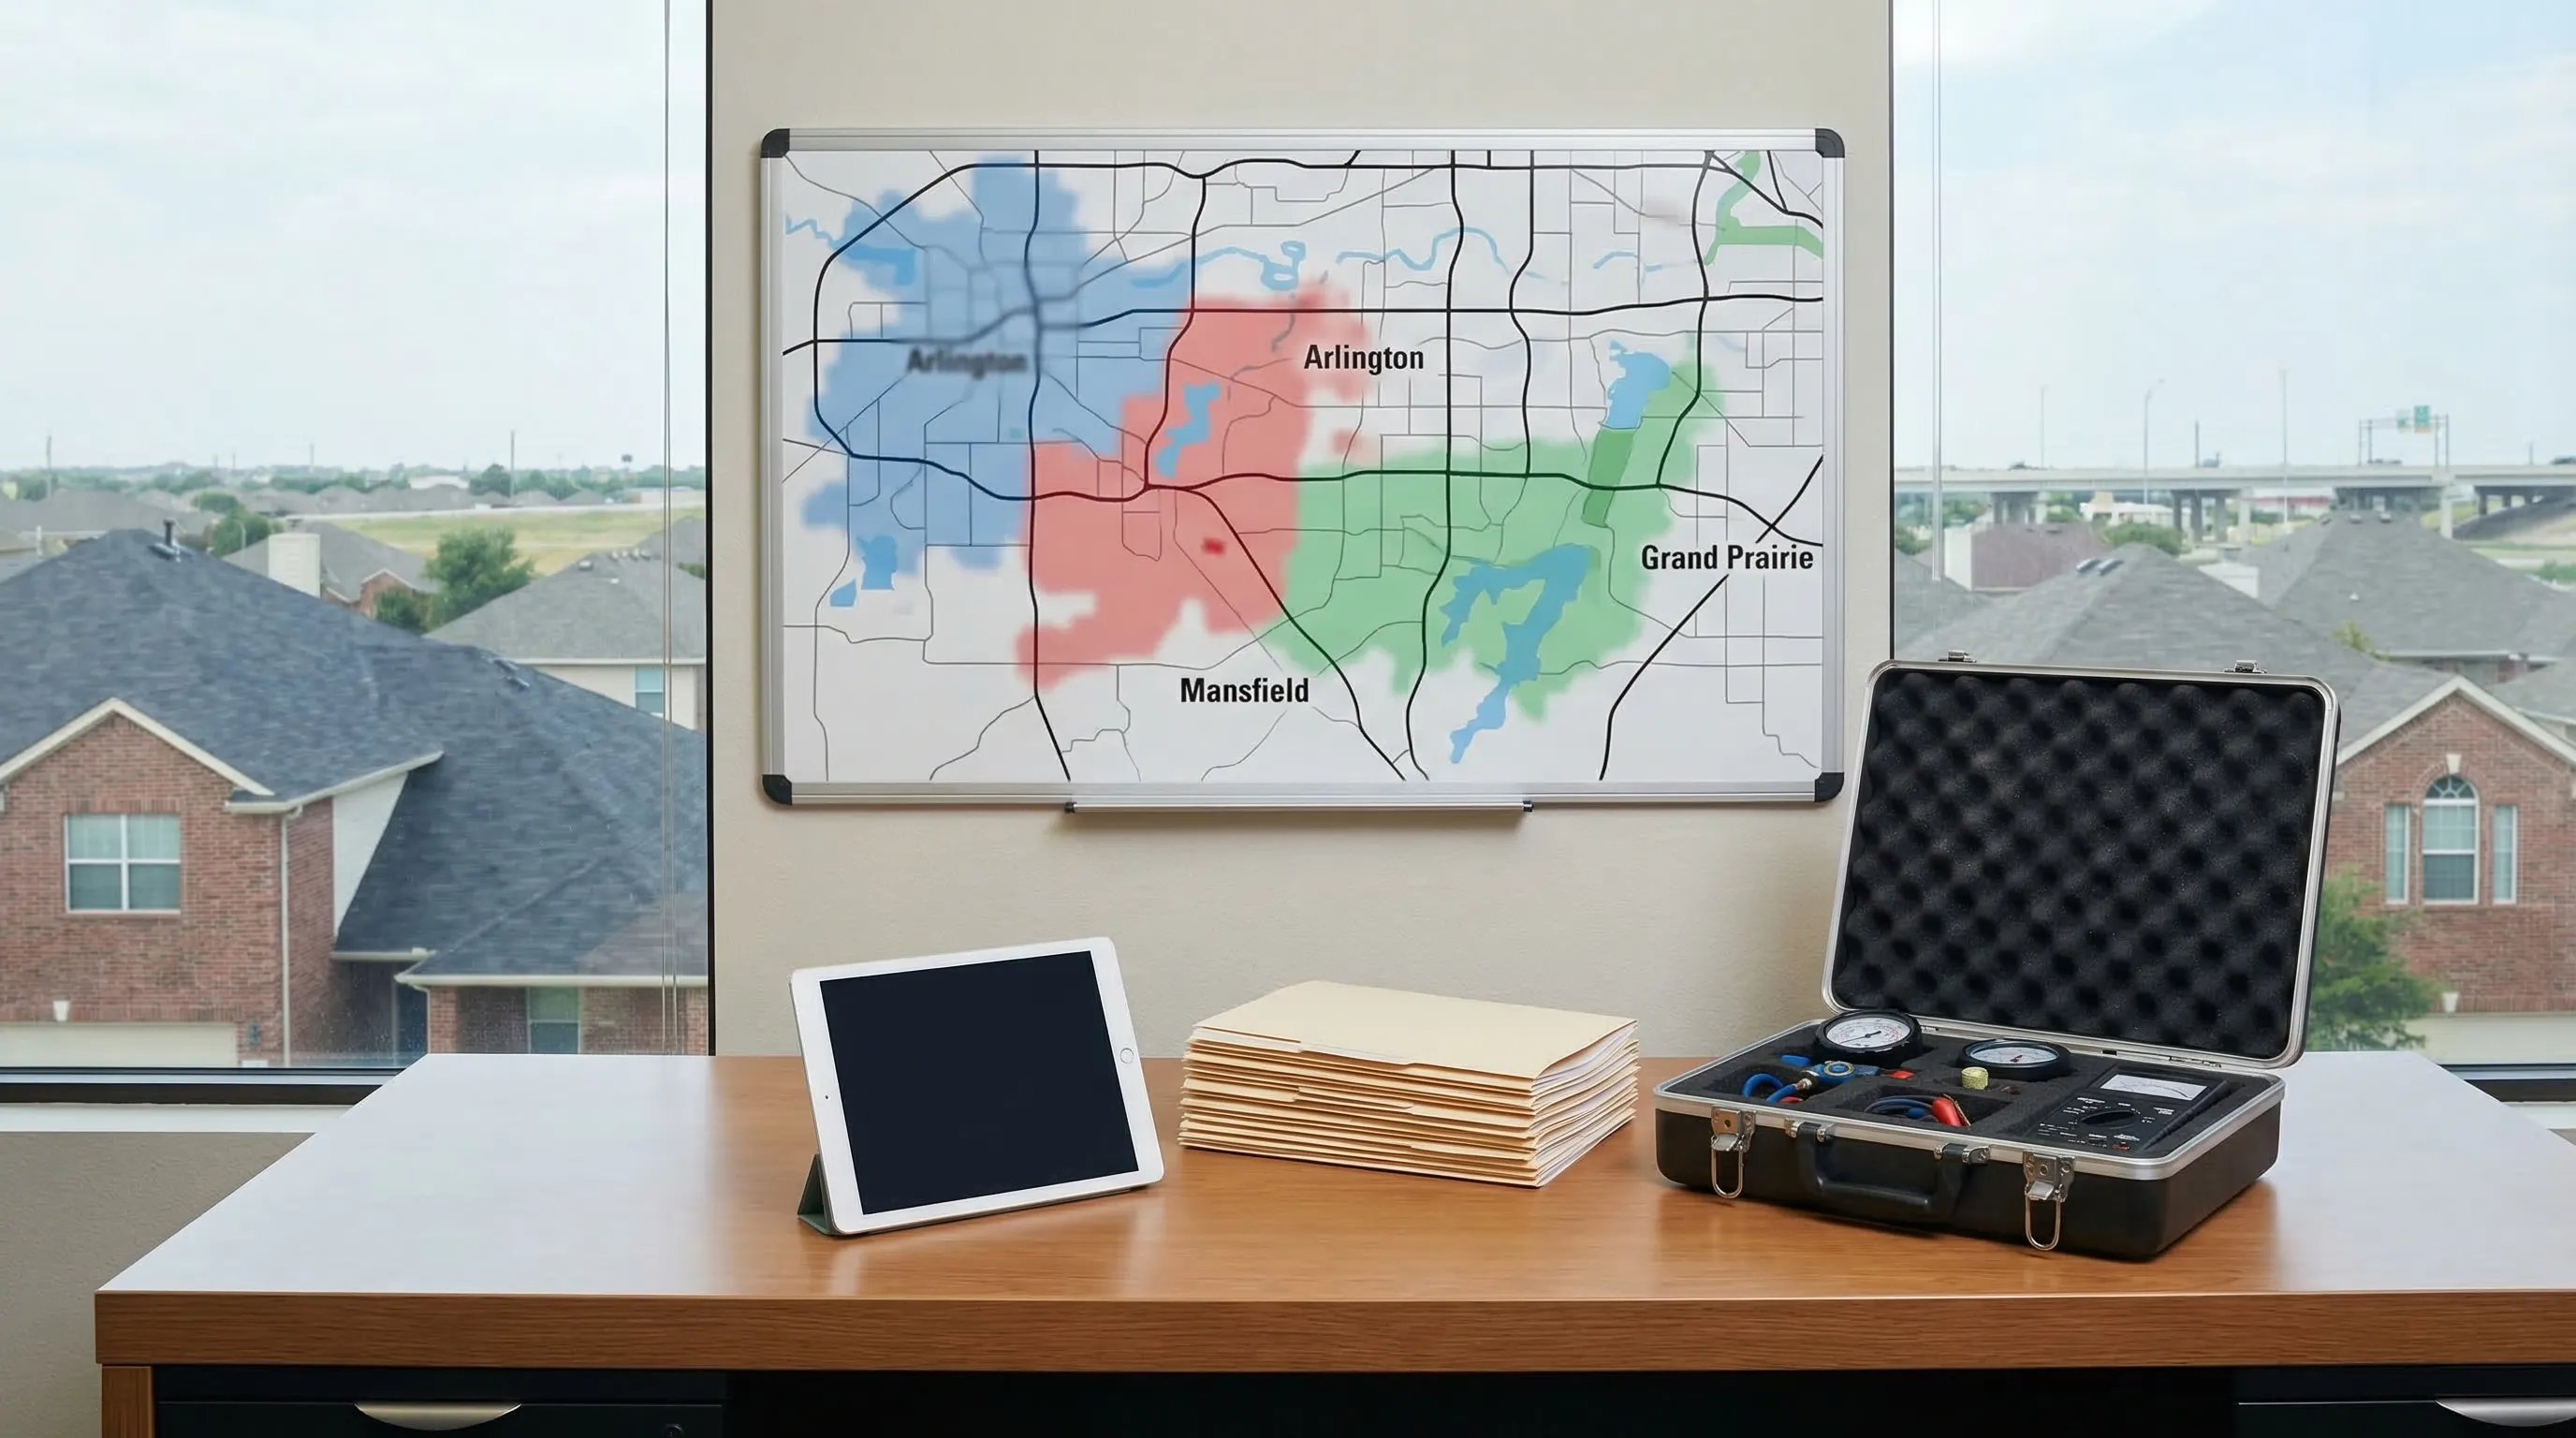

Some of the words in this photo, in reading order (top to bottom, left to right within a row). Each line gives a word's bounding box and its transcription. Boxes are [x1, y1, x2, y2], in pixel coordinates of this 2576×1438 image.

[1304, 345, 1424, 375] Arlington
[1641, 544, 1718, 570] Grand
[1727, 544, 1814, 569] Prairie
[1180, 678, 1309, 703] Mansfield
